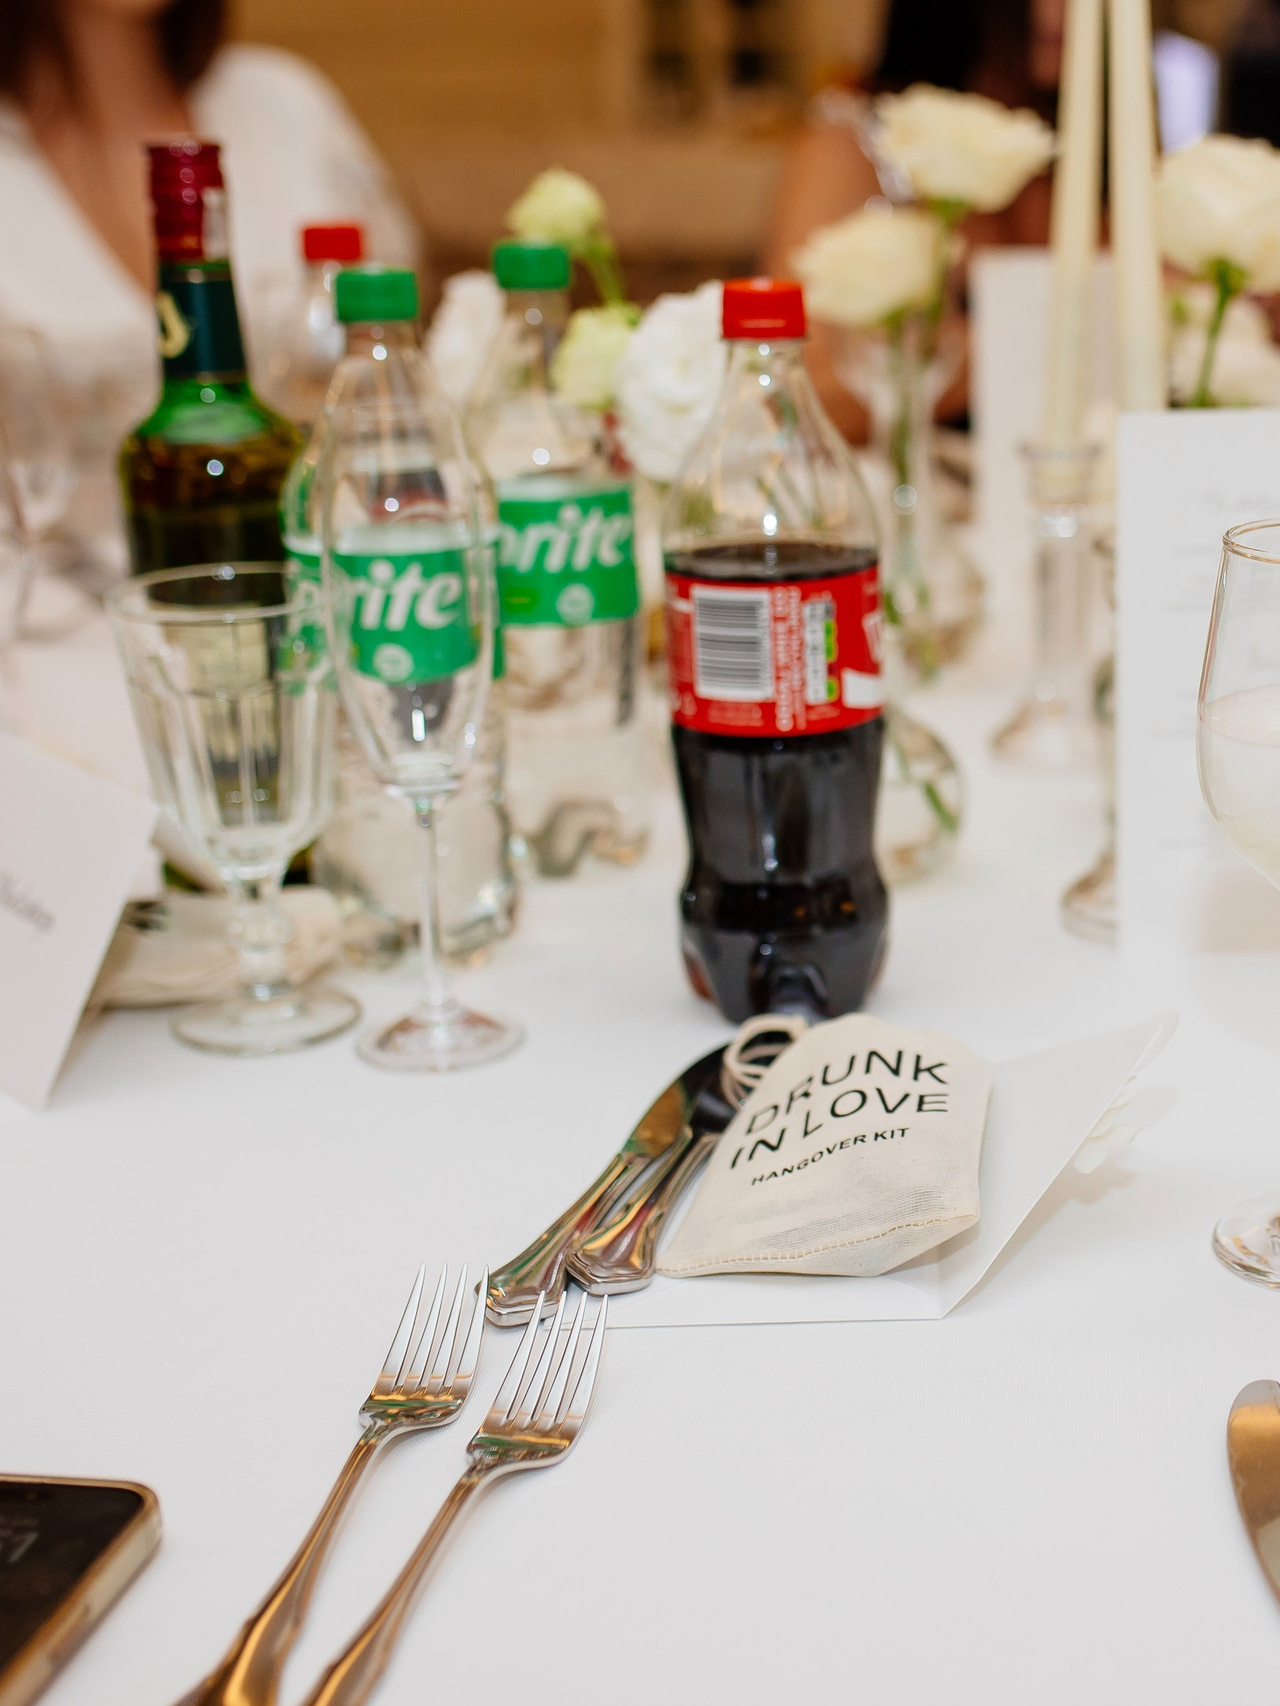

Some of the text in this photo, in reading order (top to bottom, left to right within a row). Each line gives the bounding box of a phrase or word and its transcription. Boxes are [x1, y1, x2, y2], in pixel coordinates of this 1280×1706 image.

[730, 1087, 950, 1171] IN LOVE
[745, 1049, 950, 1135] DRUNK
[751, 1127, 910, 1186] HANGOVER KIT
